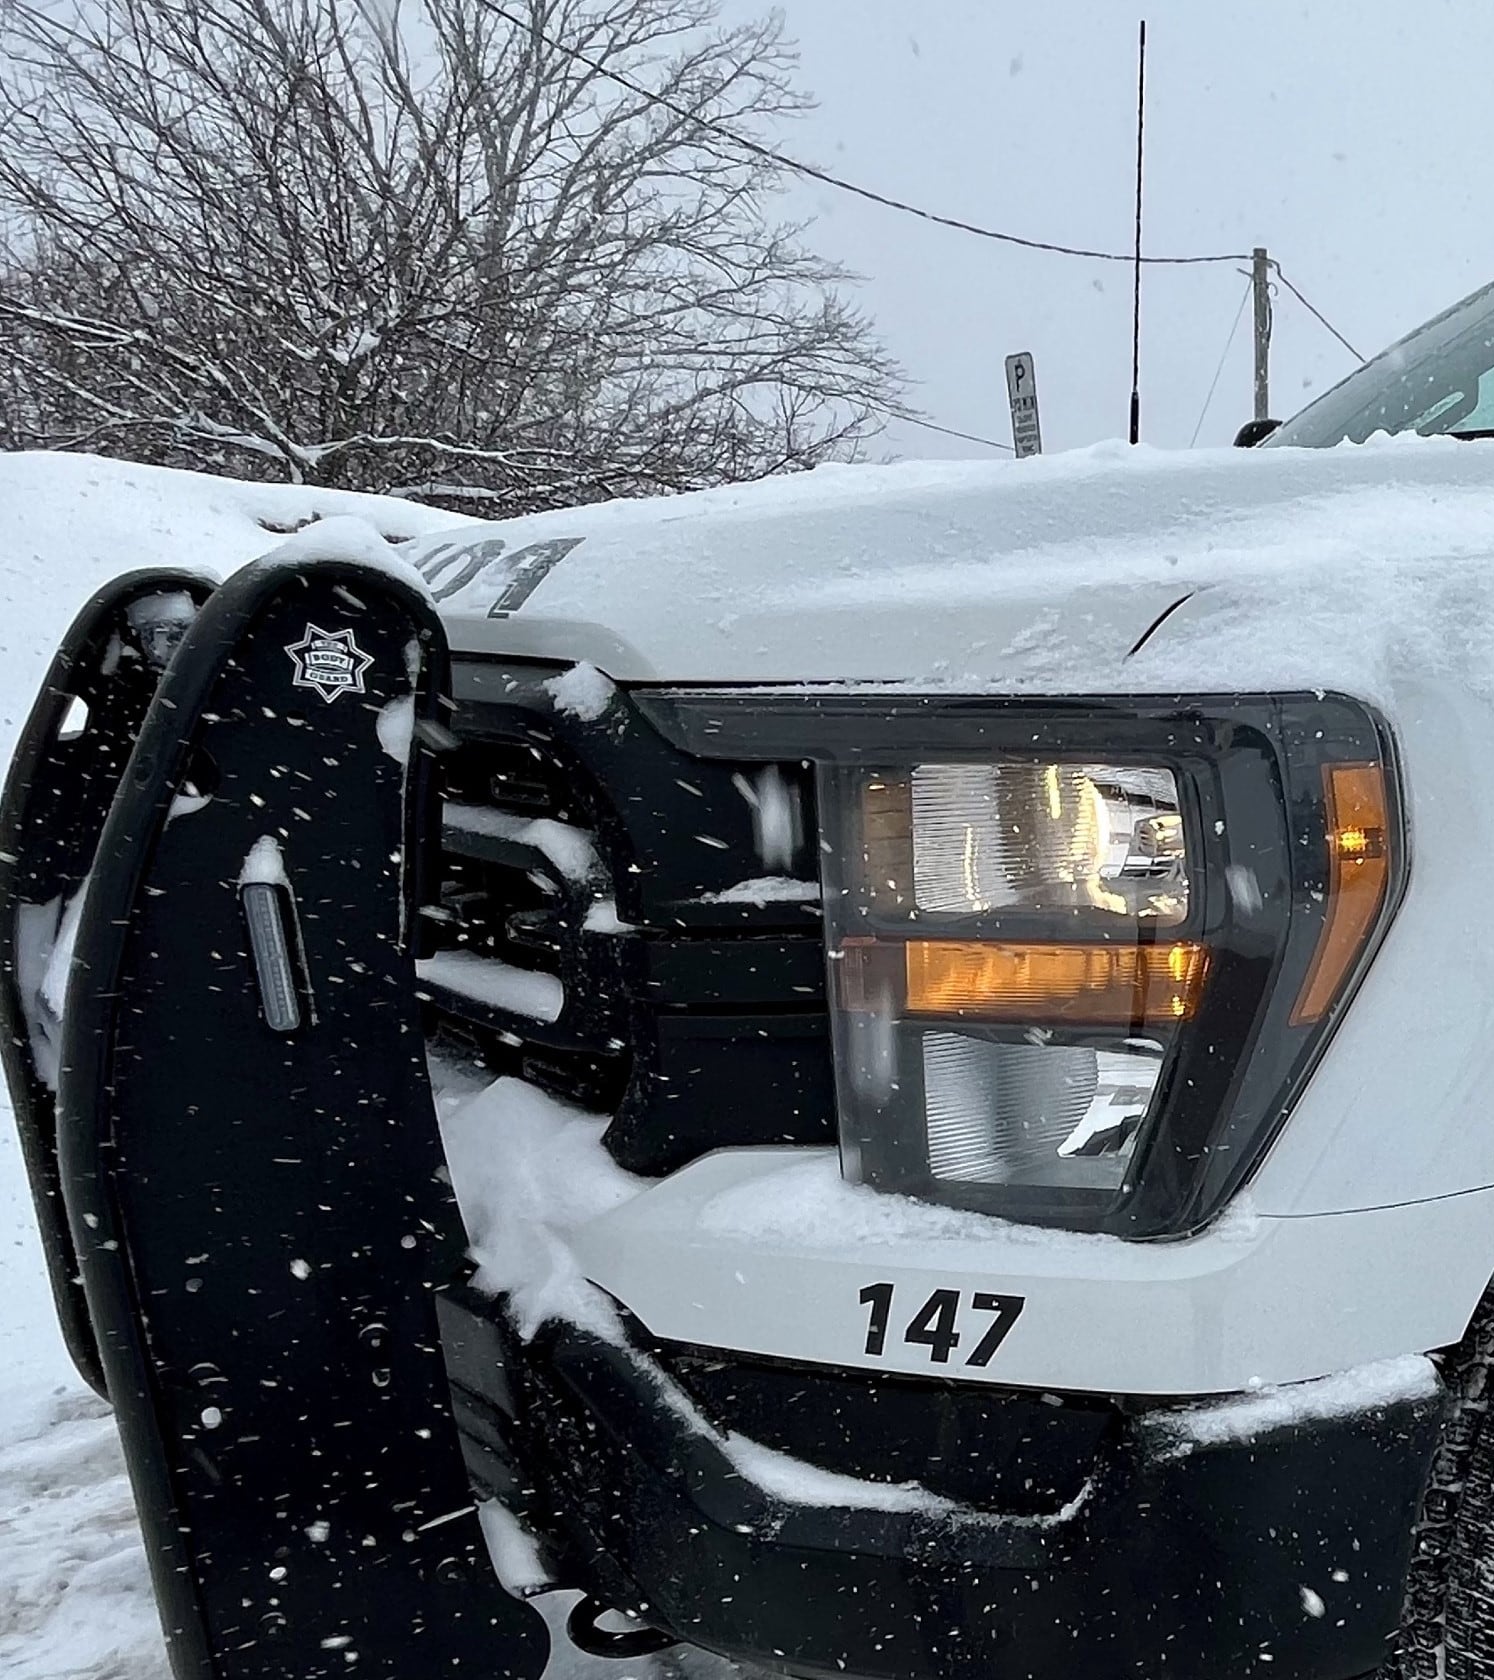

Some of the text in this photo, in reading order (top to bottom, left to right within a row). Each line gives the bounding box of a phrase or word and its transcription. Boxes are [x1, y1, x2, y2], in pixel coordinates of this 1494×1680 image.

[312, 653, 347, 664] BODY
[309, 671, 349, 682] GUARD
[858, 1282, 1026, 1368] 147
